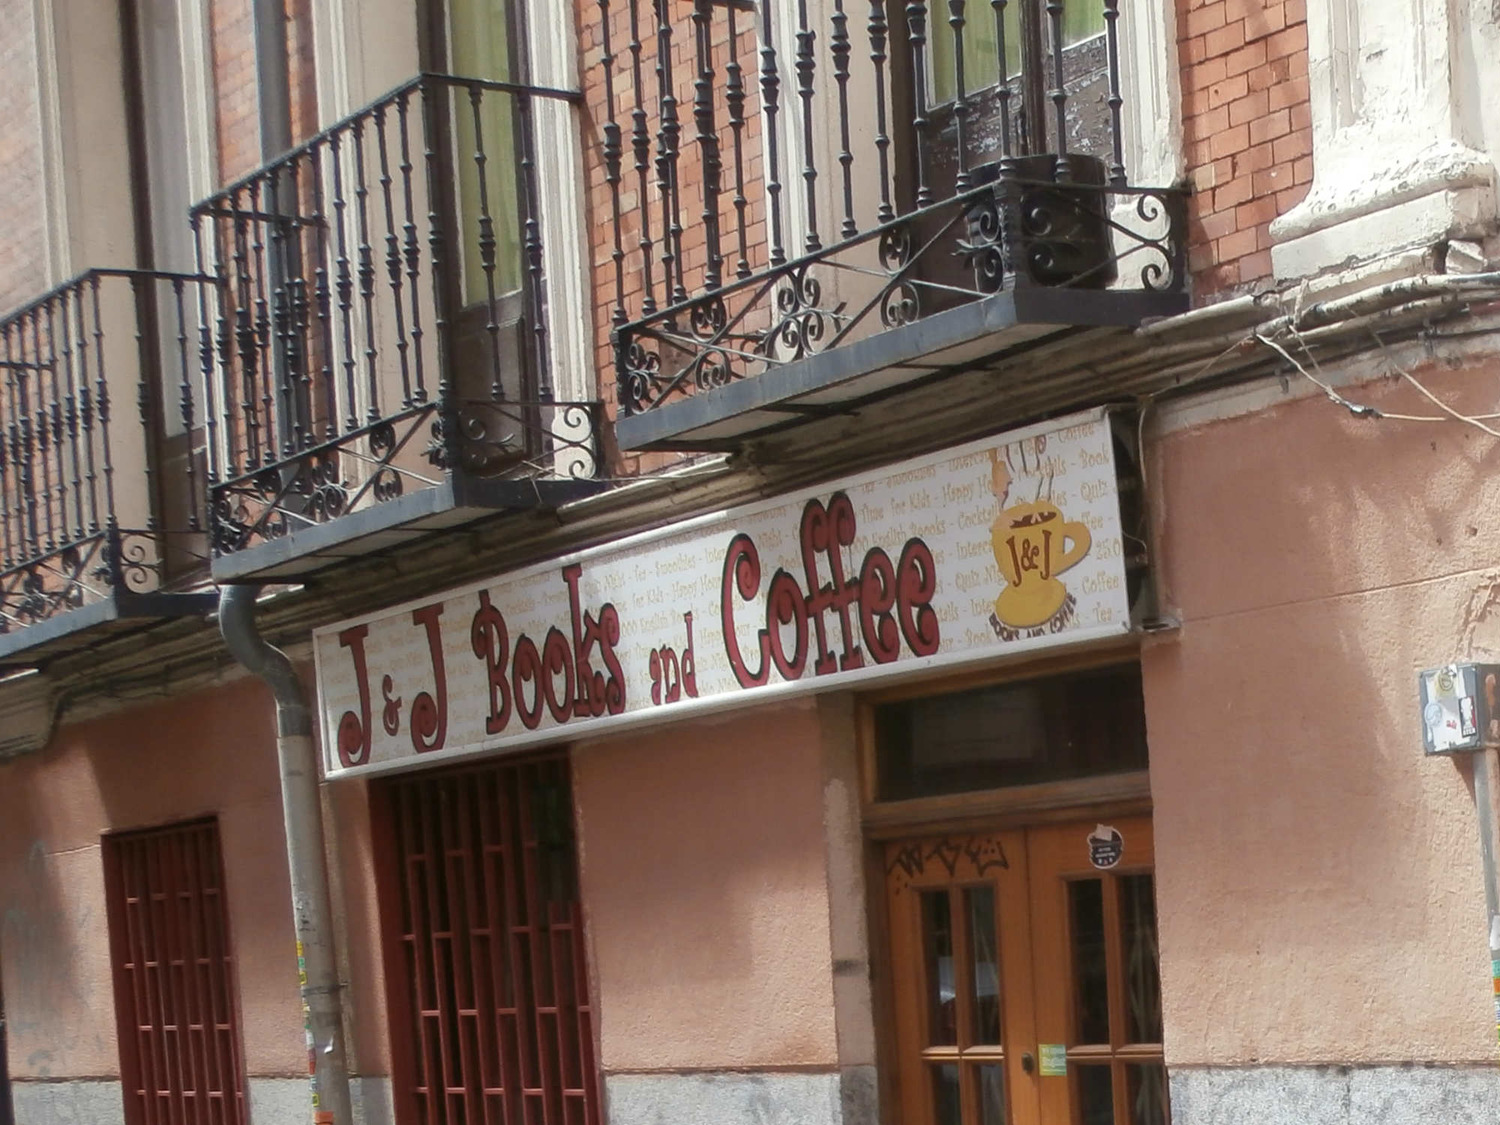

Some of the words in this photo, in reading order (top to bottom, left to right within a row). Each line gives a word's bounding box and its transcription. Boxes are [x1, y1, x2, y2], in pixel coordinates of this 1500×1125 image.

[470, 563, 627, 736] Books
[648, 609, 700, 707] and
[720, 489, 941, 690] Coffee
